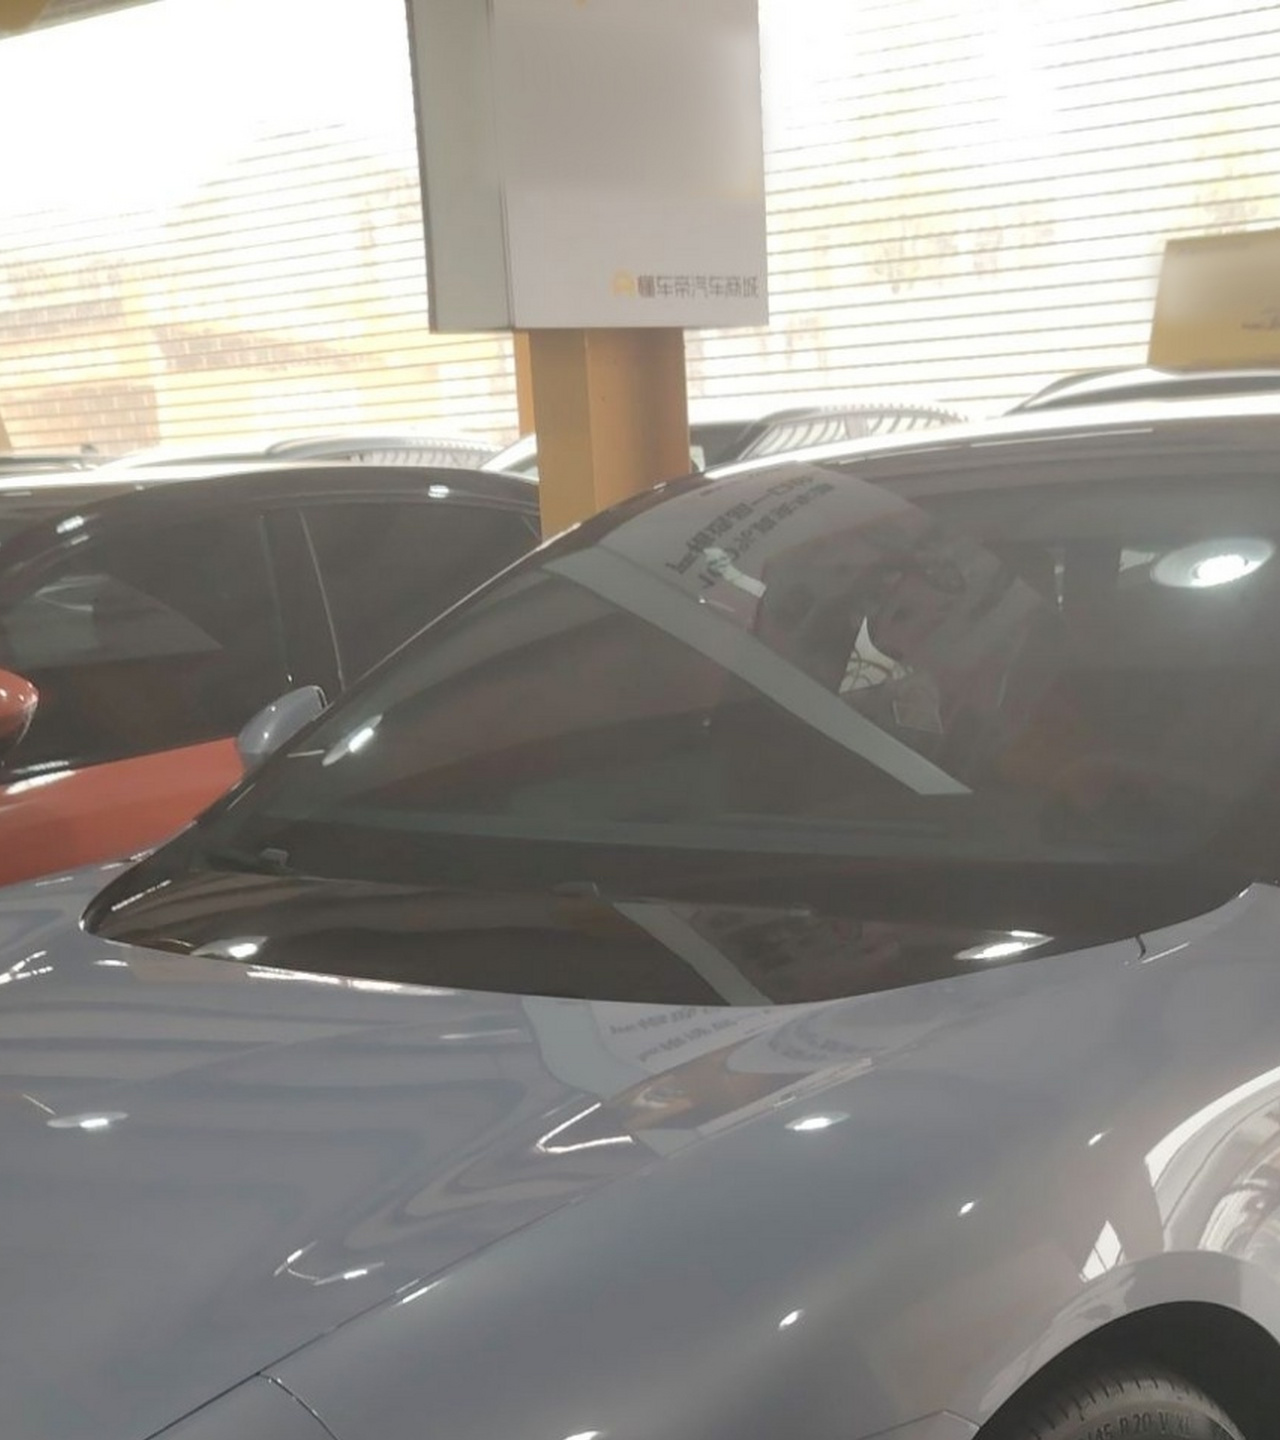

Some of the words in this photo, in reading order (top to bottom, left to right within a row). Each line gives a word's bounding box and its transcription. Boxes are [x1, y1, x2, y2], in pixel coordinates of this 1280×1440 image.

[637, 274, 759, 299] 懂车帝汽车商城
